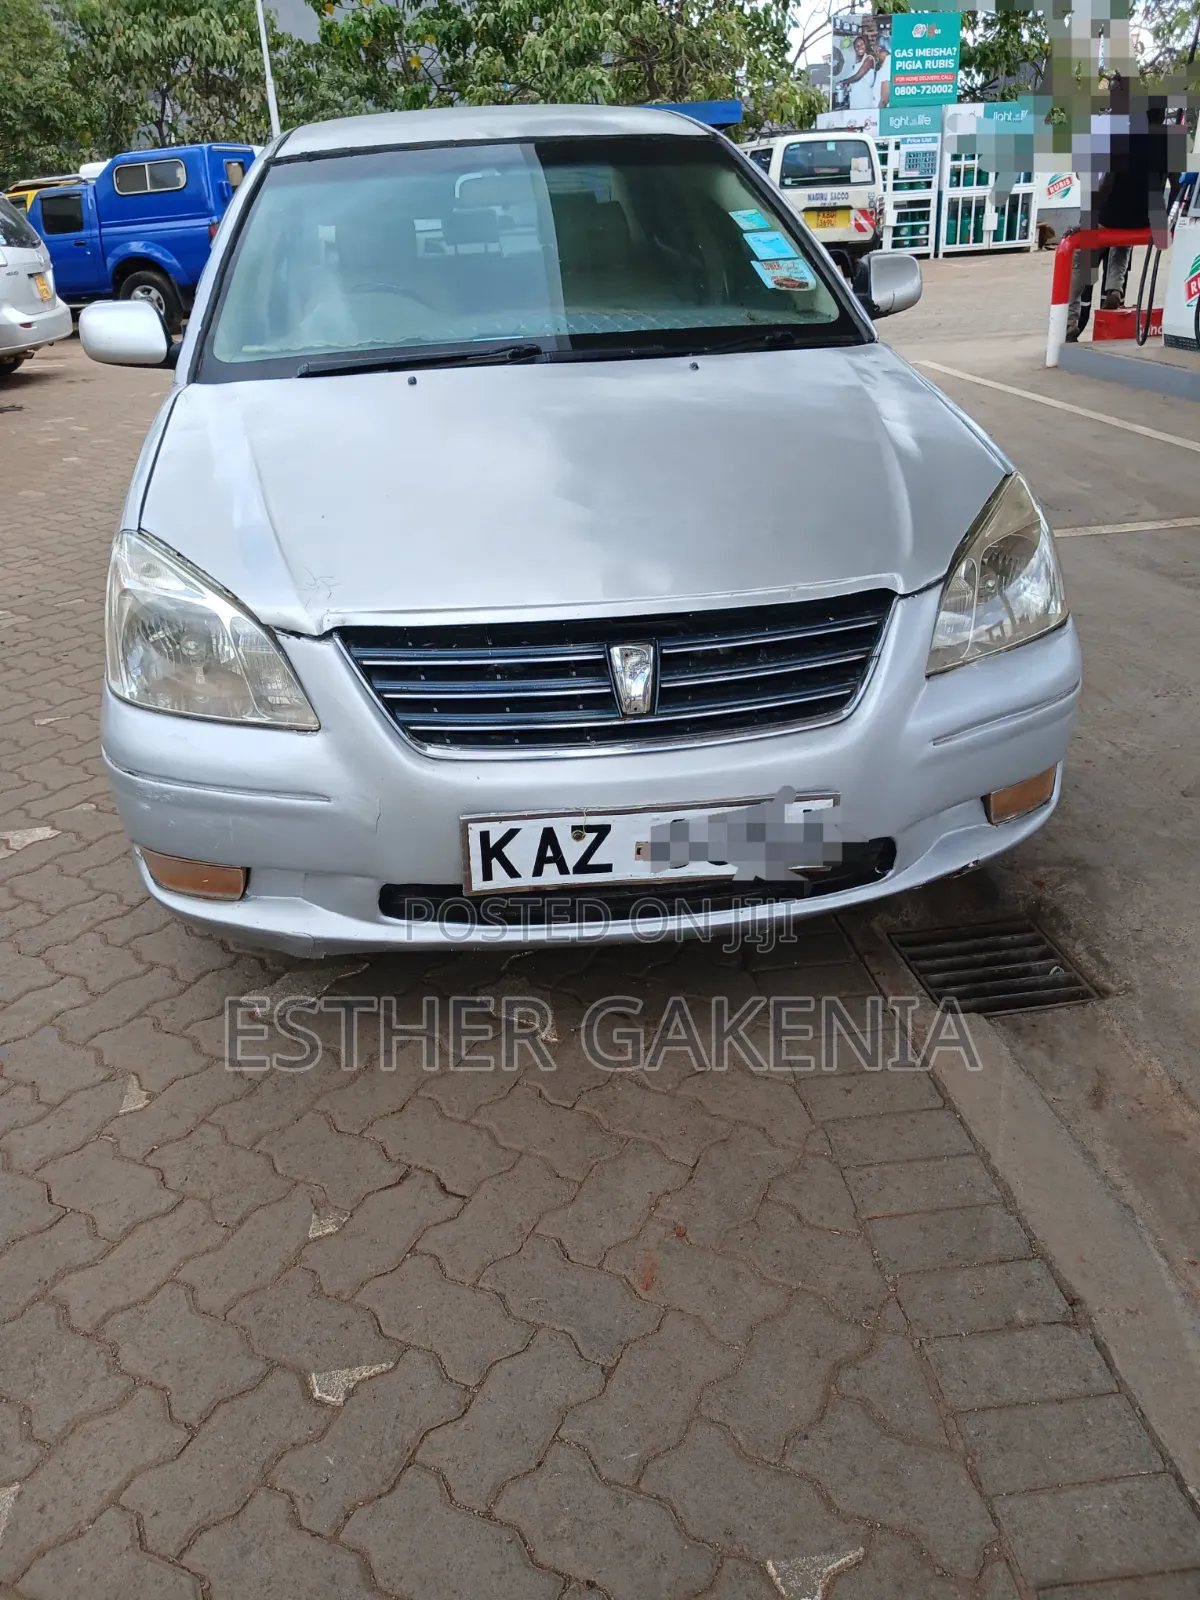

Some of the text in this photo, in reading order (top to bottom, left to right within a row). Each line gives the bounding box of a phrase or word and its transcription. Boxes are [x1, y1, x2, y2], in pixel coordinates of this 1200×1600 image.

[894, 47, 957, 58] GAS IMEISHA?
[895, 59, 955, 71] PIGIA RUBIS
[894, 84, 954, 96] 0800-720002
[889, 115, 909, 129] light
[917, 114, 931, 126] life
[1049, 178, 1071, 194] RUBIS
[478, 824, 613, 882] KAZ
